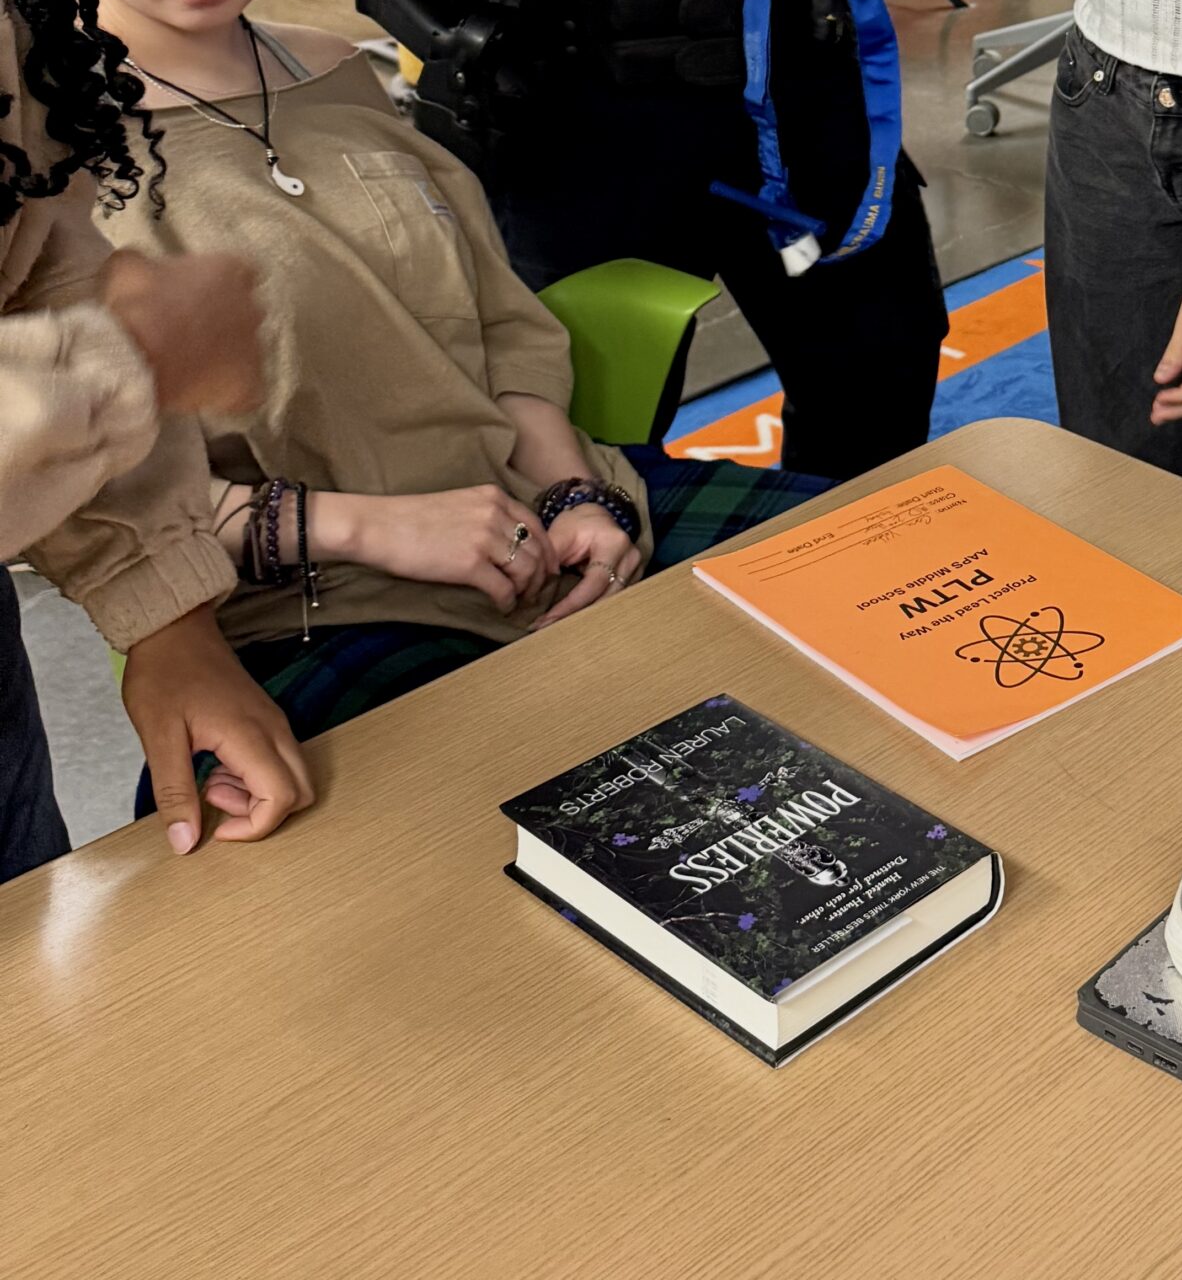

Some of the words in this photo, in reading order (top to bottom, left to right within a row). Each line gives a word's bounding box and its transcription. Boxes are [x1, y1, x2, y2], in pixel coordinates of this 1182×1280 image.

[951, 548, 990, 570] AAPS
[905, 565, 952, 590] Middle
[987, 574, 1037, 601] Project
[856, 587, 907, 611] School
[898, 568, 996, 620] PLTW
[955, 597, 991, 617] Lead
[931, 613, 955, 628] the
[899, 624, 932, 641] Way
[658, 715, 747, 764] LAUREN
[558, 758, 664, 815] ROBERTS
[668, 778, 862, 895] POWERLESS
[863, 855, 908, 884] Destined
[909, 873, 930, 888] NEW
[932, 864, 947, 876] THE
[848, 877, 863, 894] for
[863, 871, 903, 899] Hunted.
[889, 886, 912, 903] YORK
[824, 898, 865, 922] Hunter.
[825, 891, 847, 907] each
[862, 900, 890, 920] TIMES
[796, 905, 825, 925] other.
[810, 917, 865, 953] BESTSELLER
